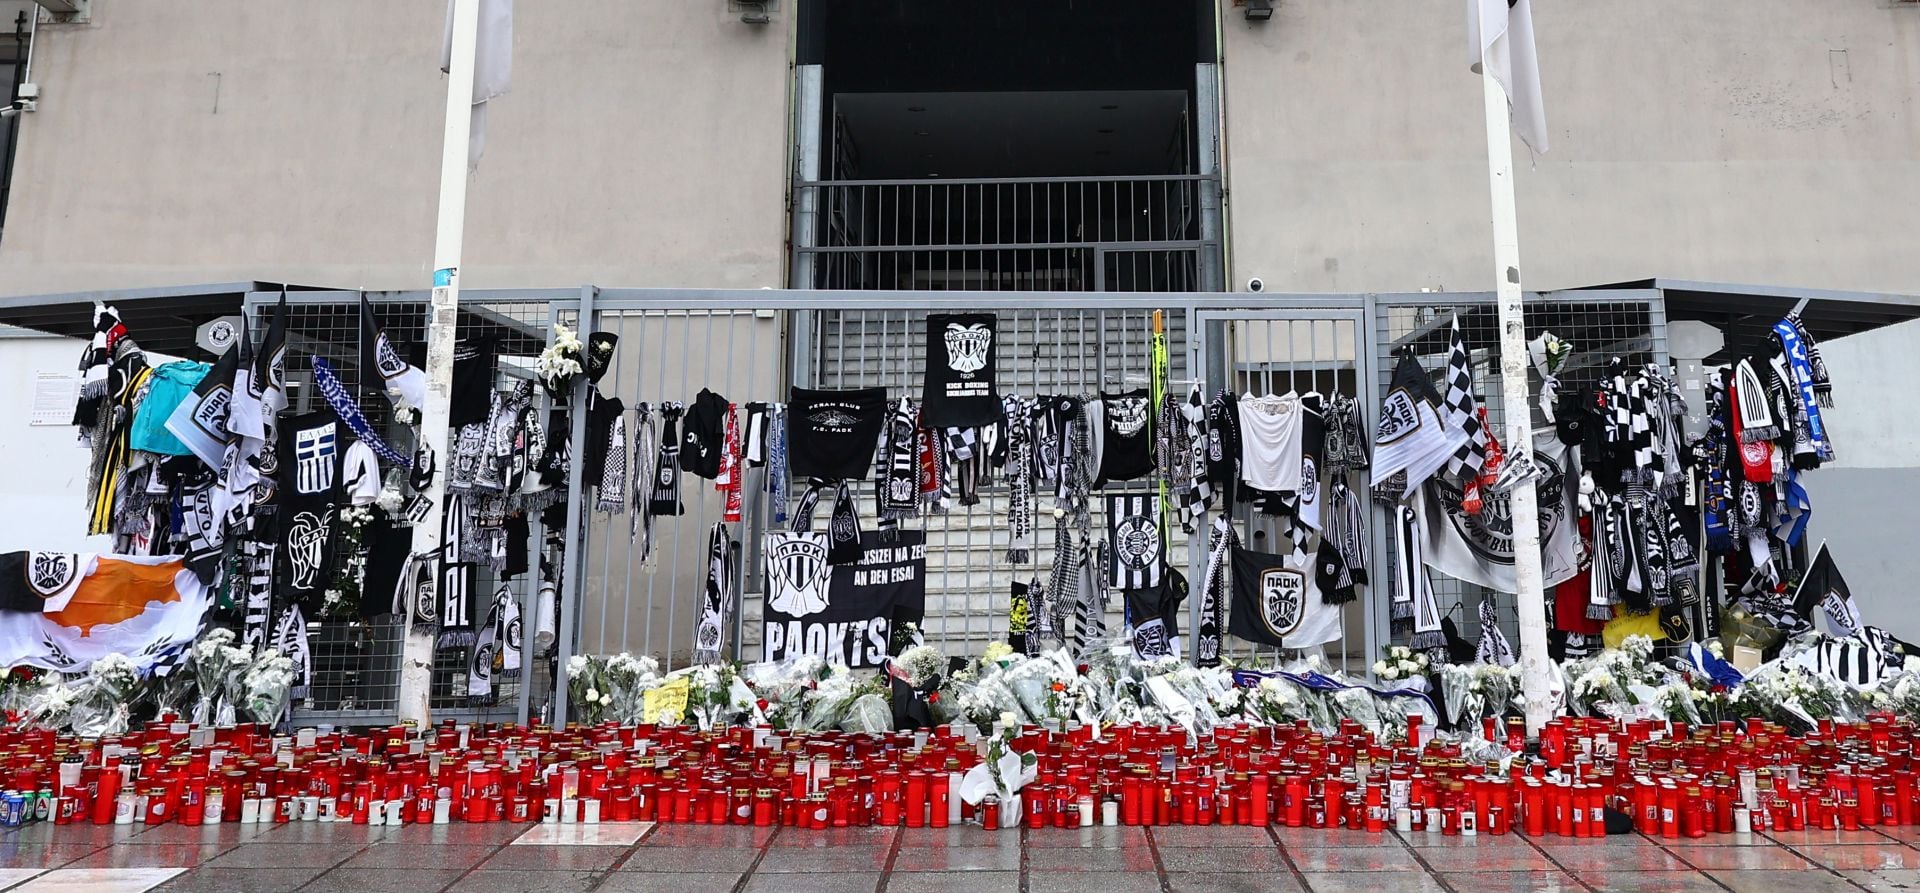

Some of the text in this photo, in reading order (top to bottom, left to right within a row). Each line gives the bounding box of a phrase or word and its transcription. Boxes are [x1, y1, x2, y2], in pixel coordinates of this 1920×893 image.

[1394, 394, 1415, 427] ΠΑΟΚ
[780, 544, 821, 558] ΠΑΟΚ
[895, 546, 908, 563] NA
[854, 565, 915, 586] AN DEN EISAI
[1267, 577, 1299, 588] ΠΑΟΚ
